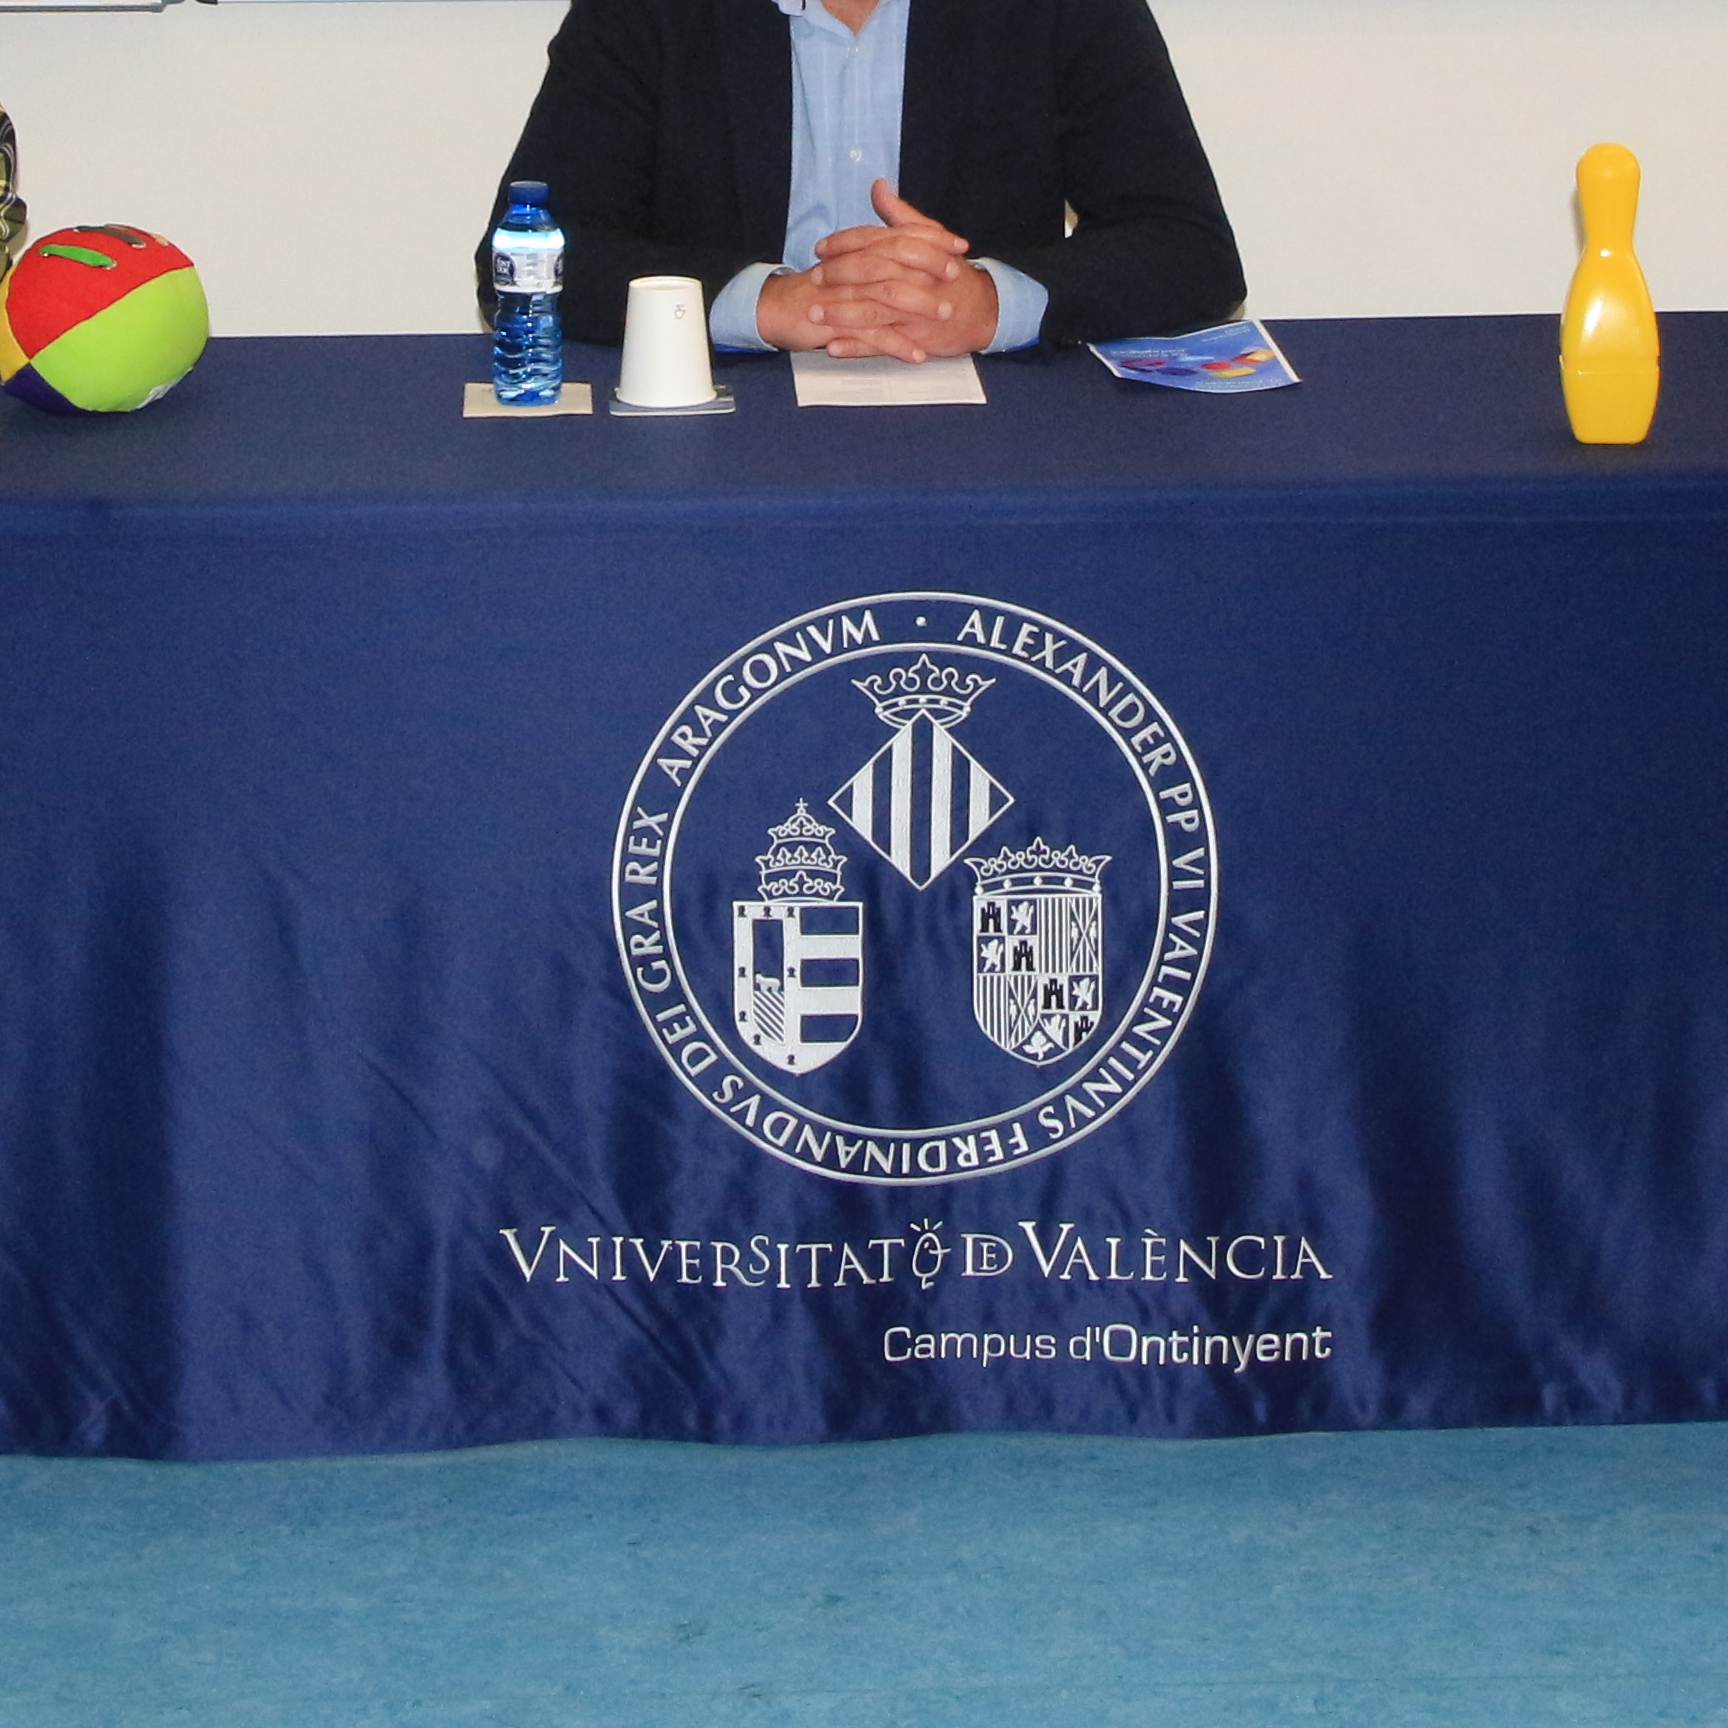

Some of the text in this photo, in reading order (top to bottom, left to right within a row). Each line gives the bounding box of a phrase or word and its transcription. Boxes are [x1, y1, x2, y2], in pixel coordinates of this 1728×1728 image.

[623, 609, 1207, 1175] ALEXANDER PP VI VALENTINVS FERDINANDVS DEI GRA REX ARAGONVM
[499, 1224, 905, 1290] VNIVERSITAT
[883, 1323, 1333, 1374] Campus d'Ontinyent
